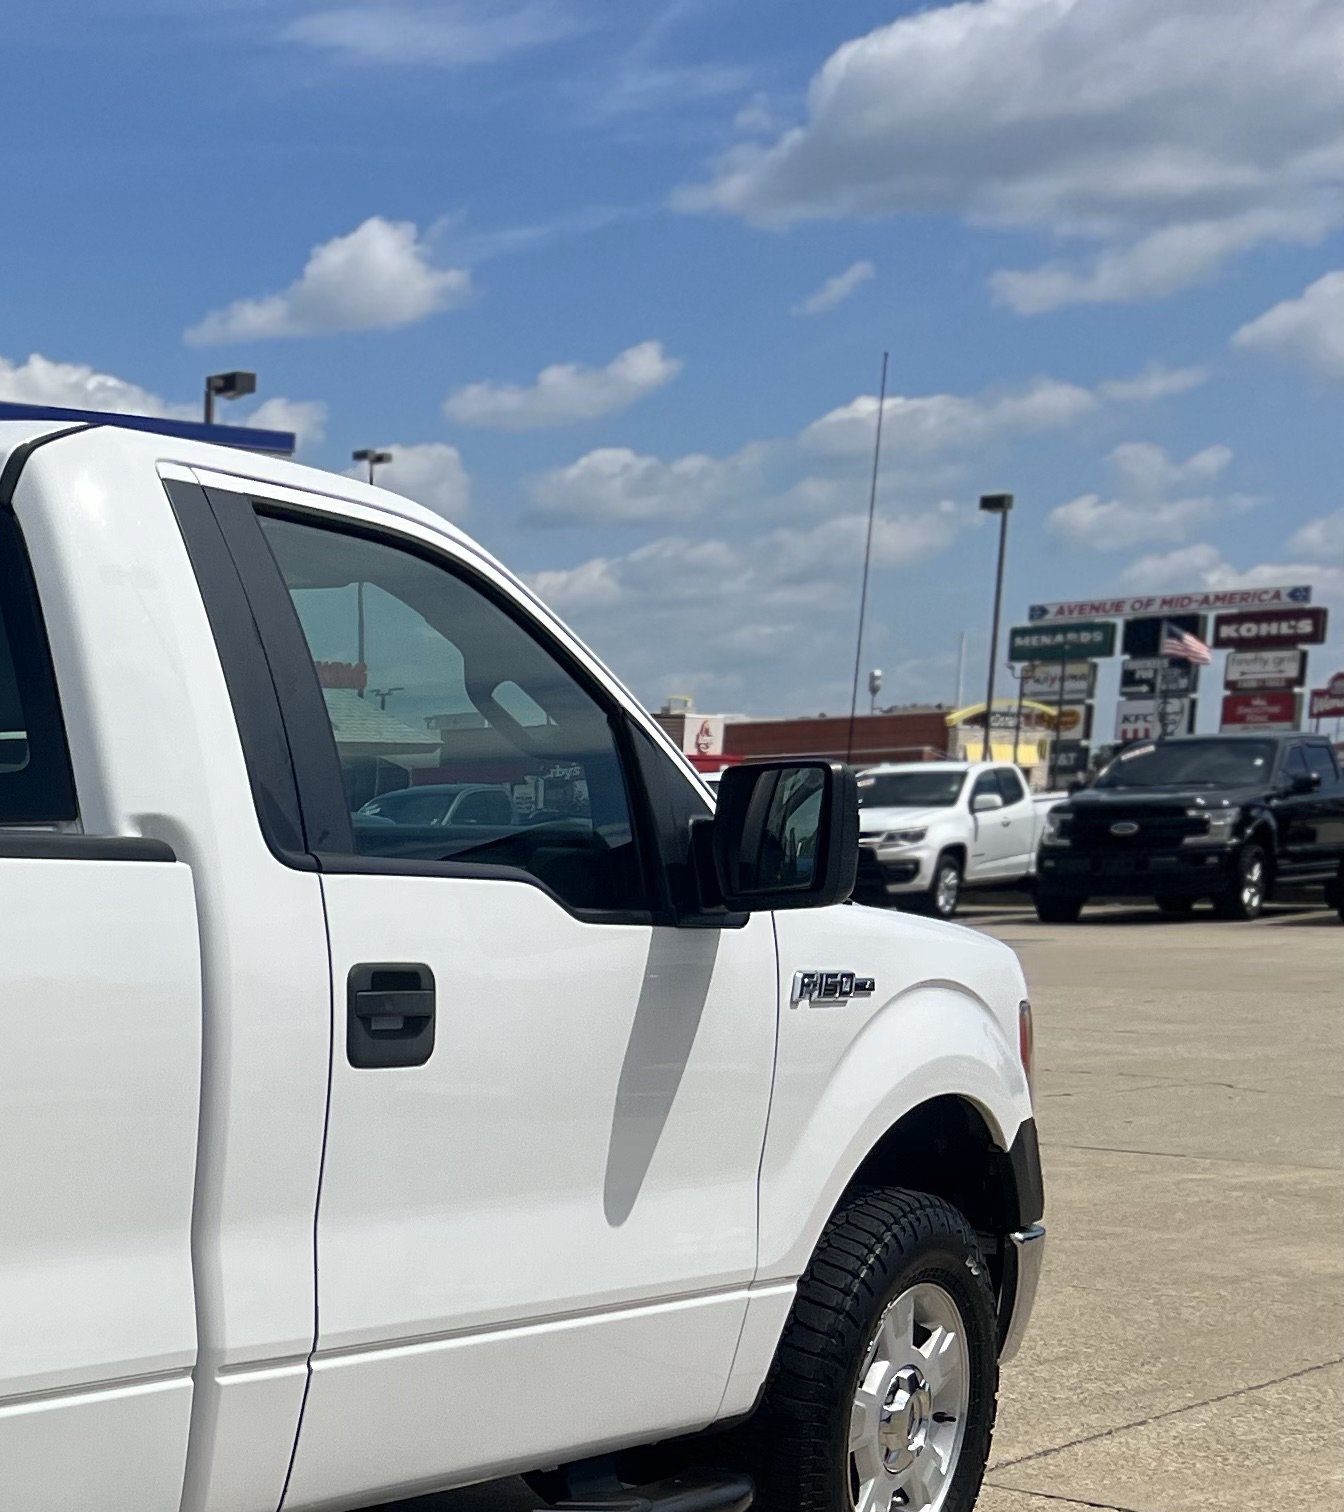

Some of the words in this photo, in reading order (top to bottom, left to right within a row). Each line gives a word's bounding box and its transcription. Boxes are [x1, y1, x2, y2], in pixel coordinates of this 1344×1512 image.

[1054, 600, 1125, 617] AVENUE
[1130, 598, 1157, 611] OF
[1159, 589, 1282, 609] MID-AMERICA
[1219, 618, 1314, 639] KOHL'S
[1014, 630, 1103, 648] MENARDS
[1121, 713, 1154, 724] KFC
